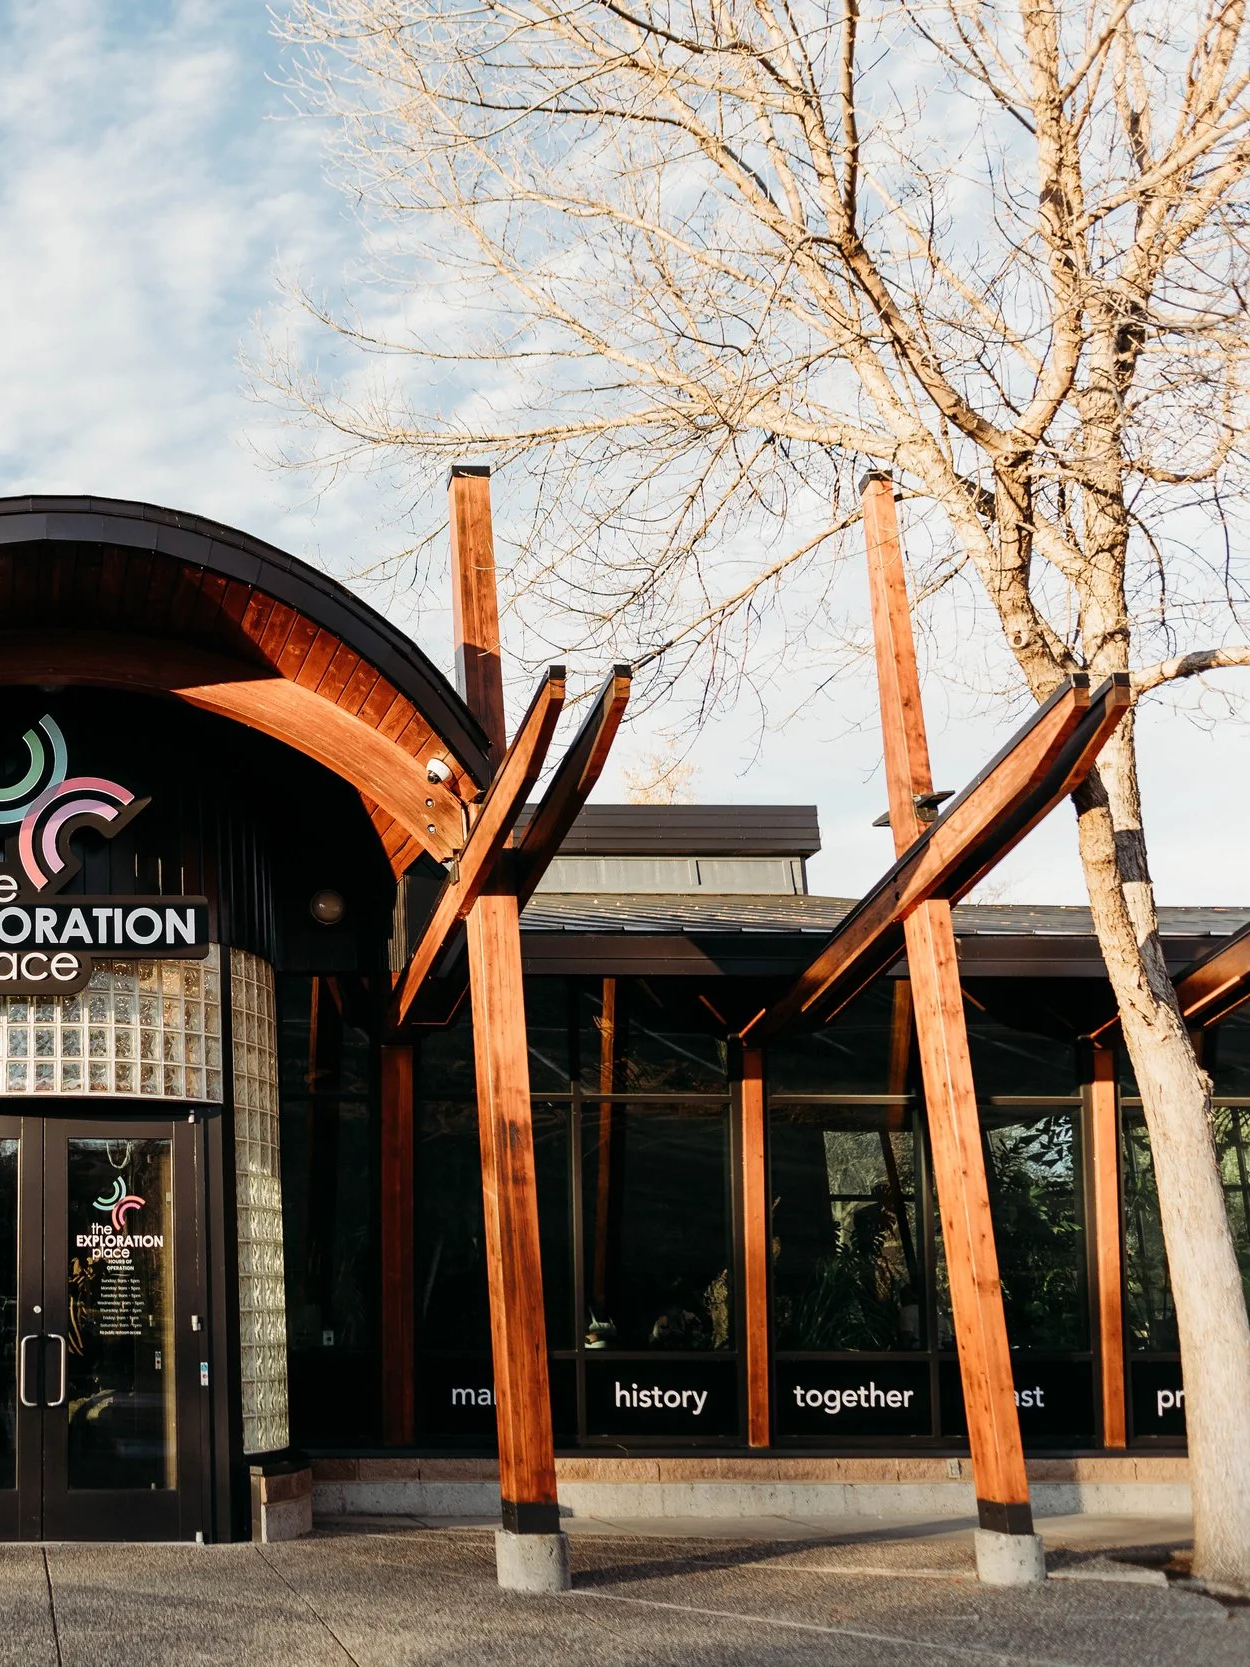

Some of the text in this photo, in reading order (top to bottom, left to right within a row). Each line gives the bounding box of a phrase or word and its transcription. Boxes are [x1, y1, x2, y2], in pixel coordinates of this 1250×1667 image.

[91, 1222, 113, 1235] the
[76, 1235, 164, 1248] EXPLORATION
[92, 1246, 130, 1260] place
[615, 1382, 707, 1415] history
[793, 1382, 914, 1414] together
